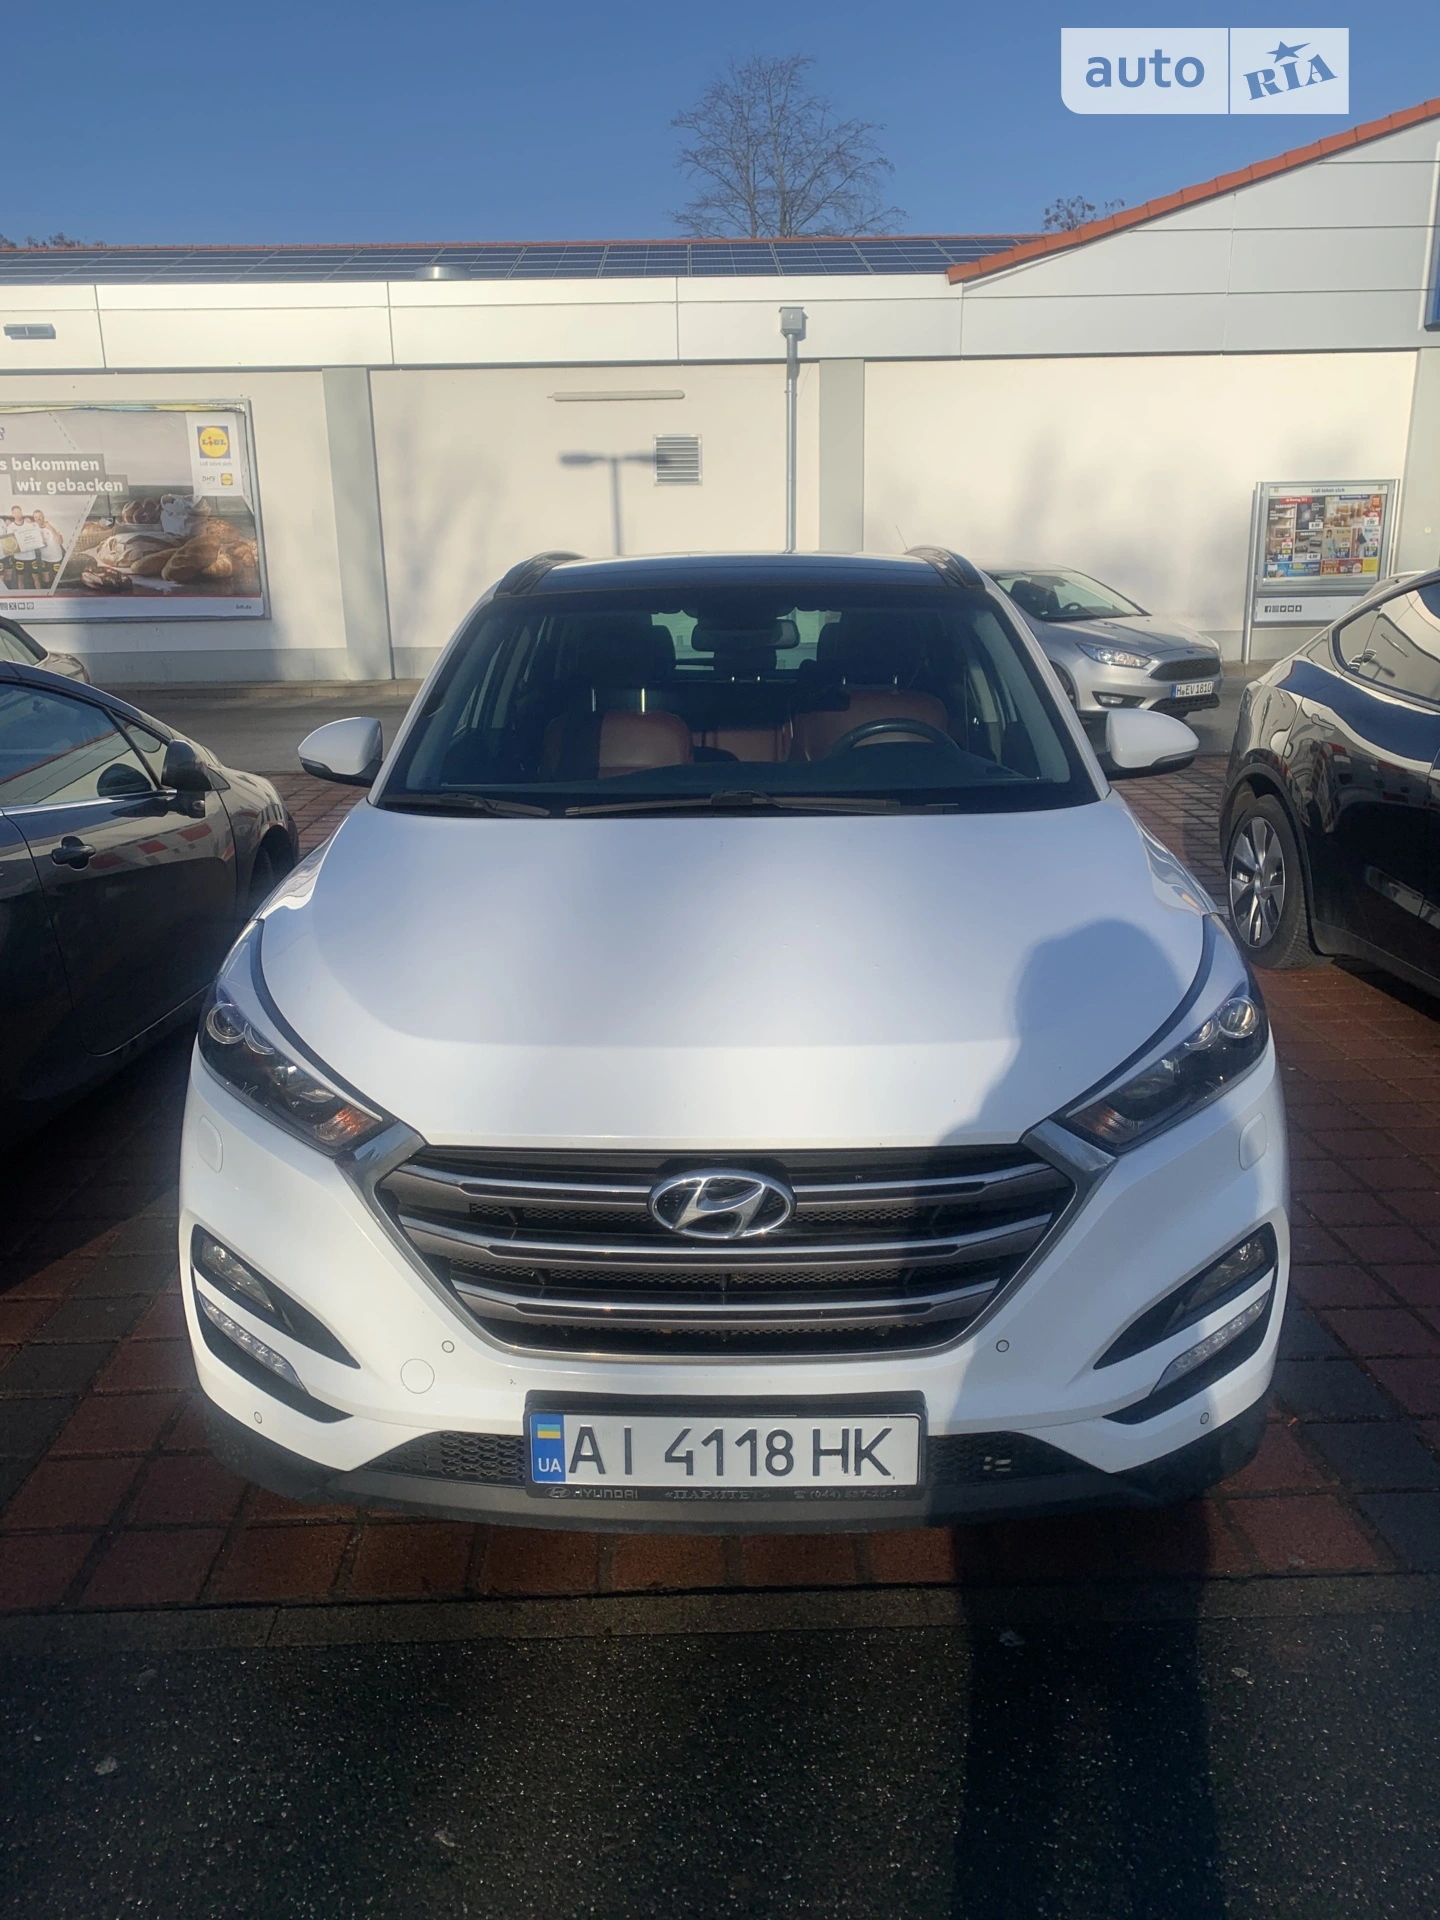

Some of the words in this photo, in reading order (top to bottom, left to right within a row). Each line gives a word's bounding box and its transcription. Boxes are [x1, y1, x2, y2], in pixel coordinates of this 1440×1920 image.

[12, 457, 100, 471] bekommen
[16, 477, 41, 492] wir
[46, 477, 123, 495] gebacken
[568, 1425, 632, 1475] AI
[664, 1426, 794, 1477] 4118
[811, 1427, 892, 1477] HK
[538, 1458, 562, 1473] UA
[573, 1489, 639, 1499] HYUNDAI
